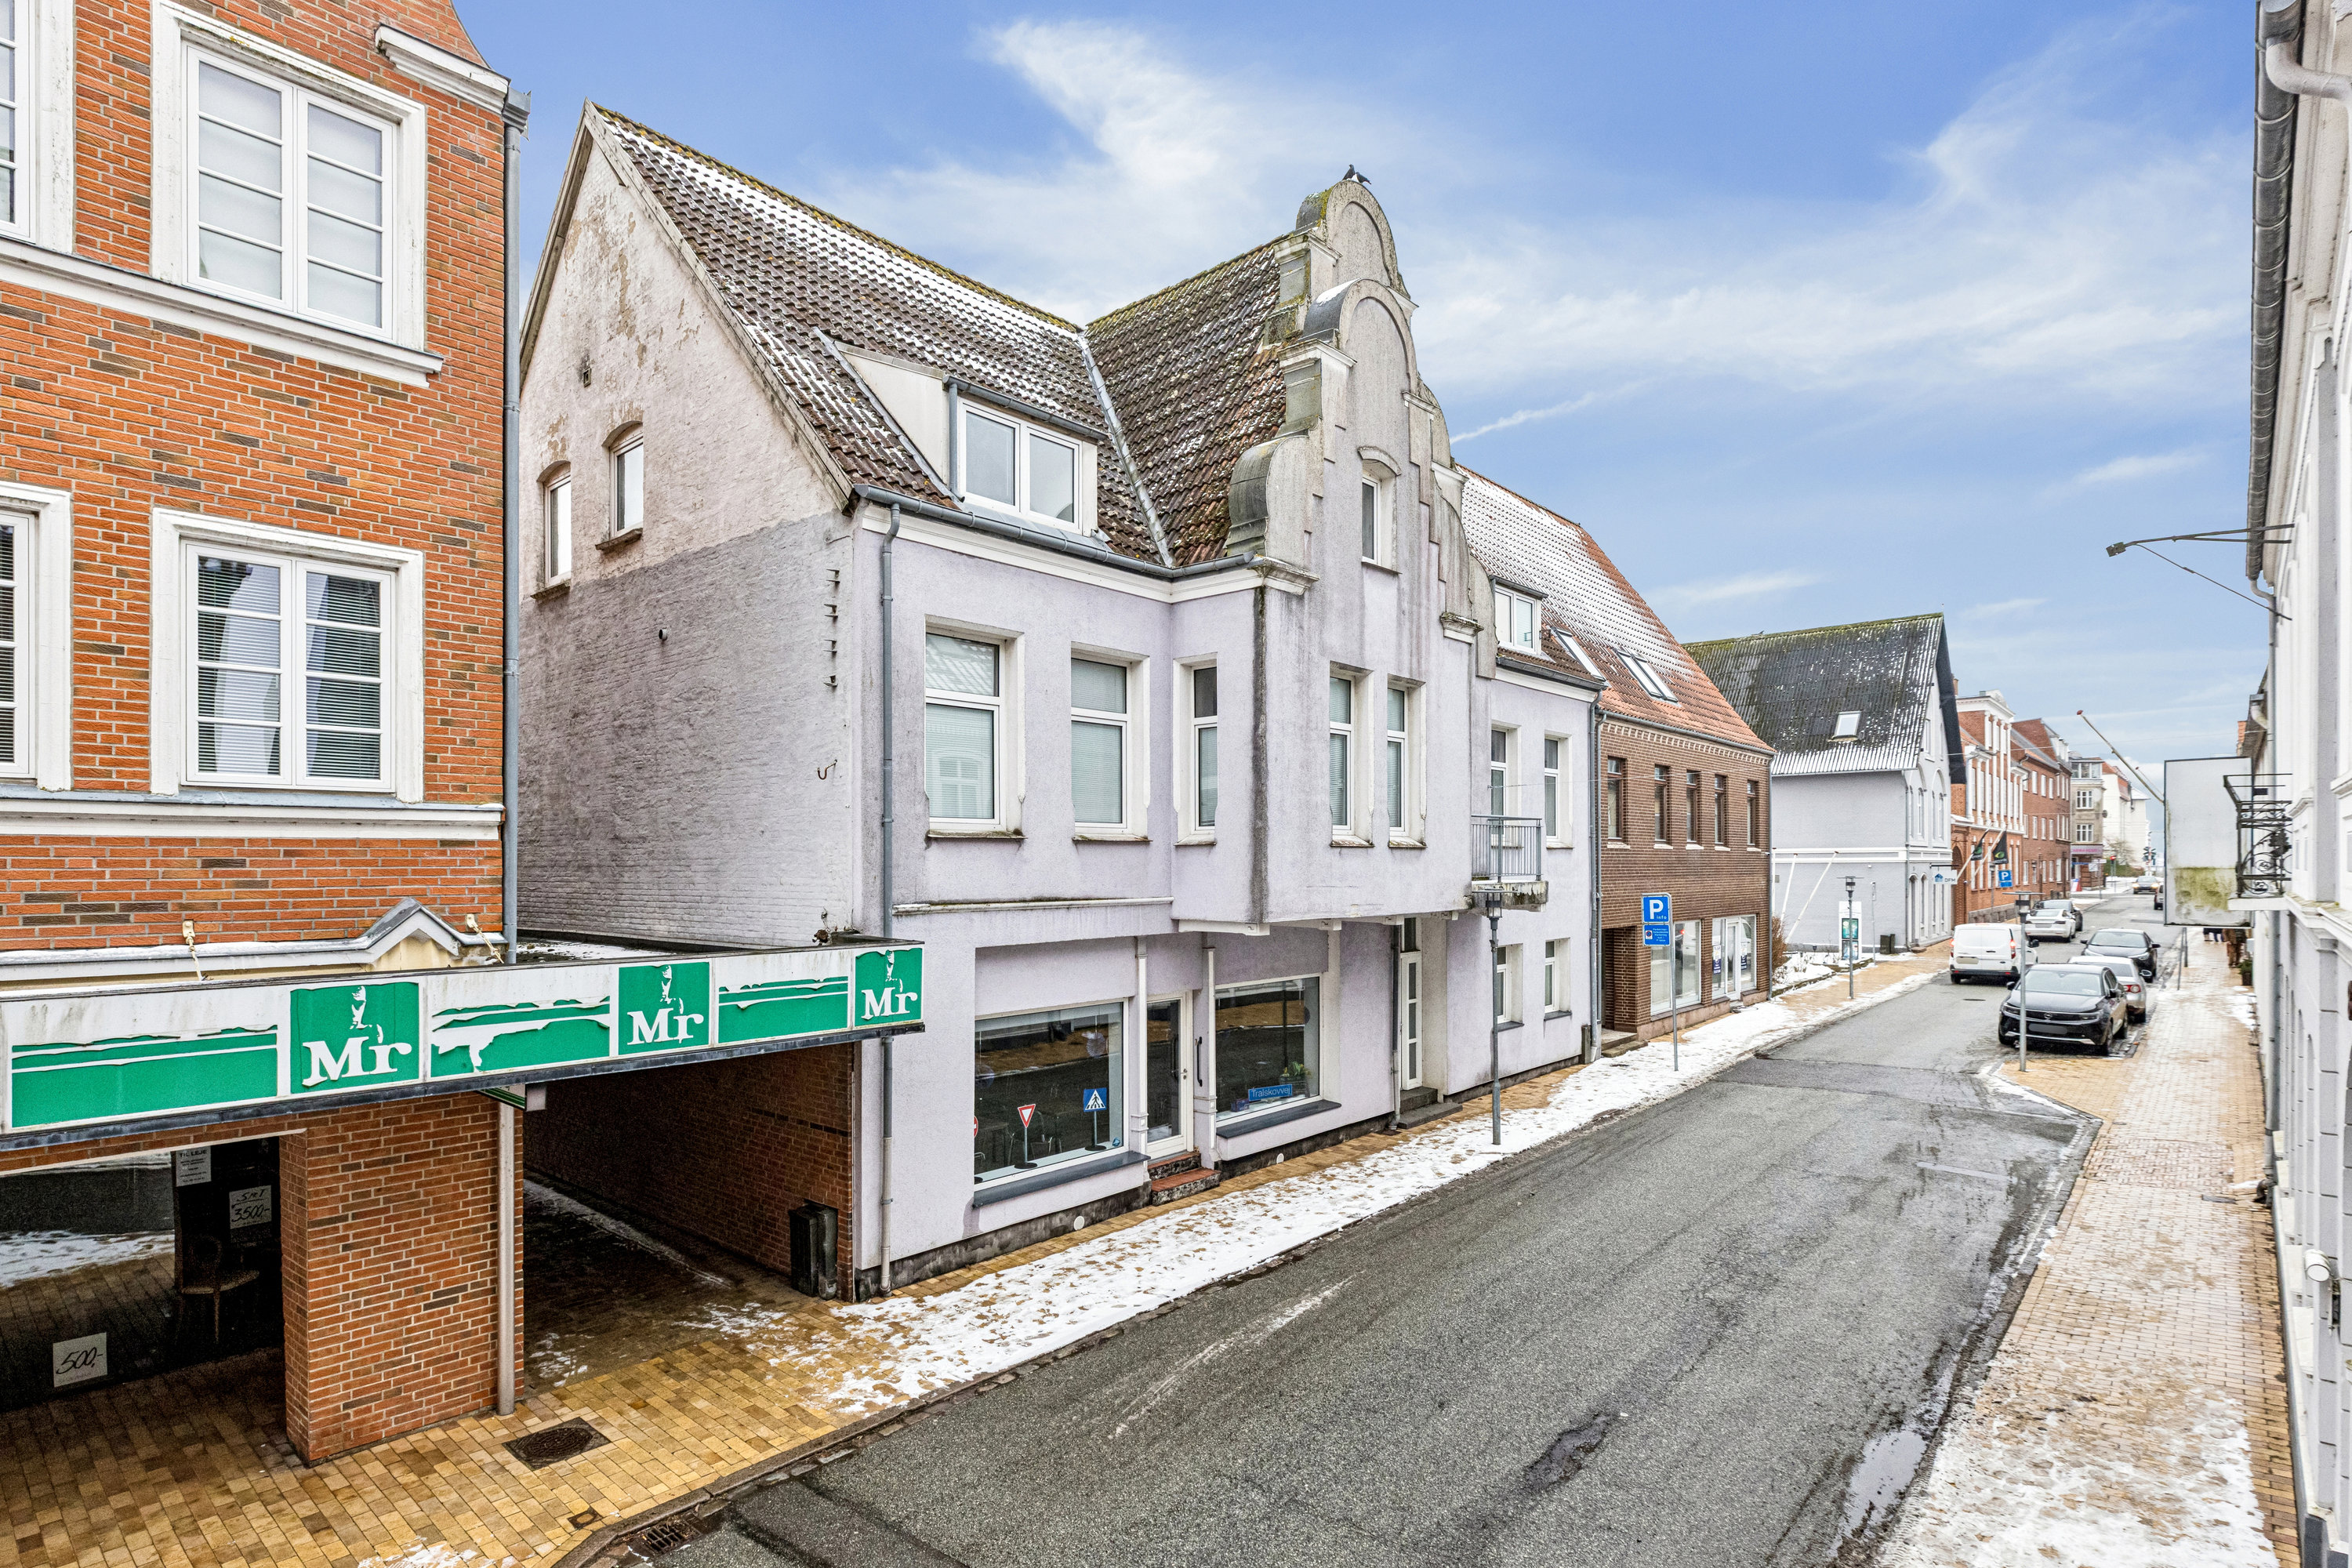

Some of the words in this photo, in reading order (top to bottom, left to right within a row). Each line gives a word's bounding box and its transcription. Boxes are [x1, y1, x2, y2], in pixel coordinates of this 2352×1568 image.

[1650, 899, 1664, 920] P
[861, 987, 918, 1020] Mr
[627, 1007, 704, 1045] Mr
[302, 1036, 412, 1087] Mr
[1251, 1087, 1290, 1097] Tralskovvej
[56, 1347, 103, 1374] 500,-
